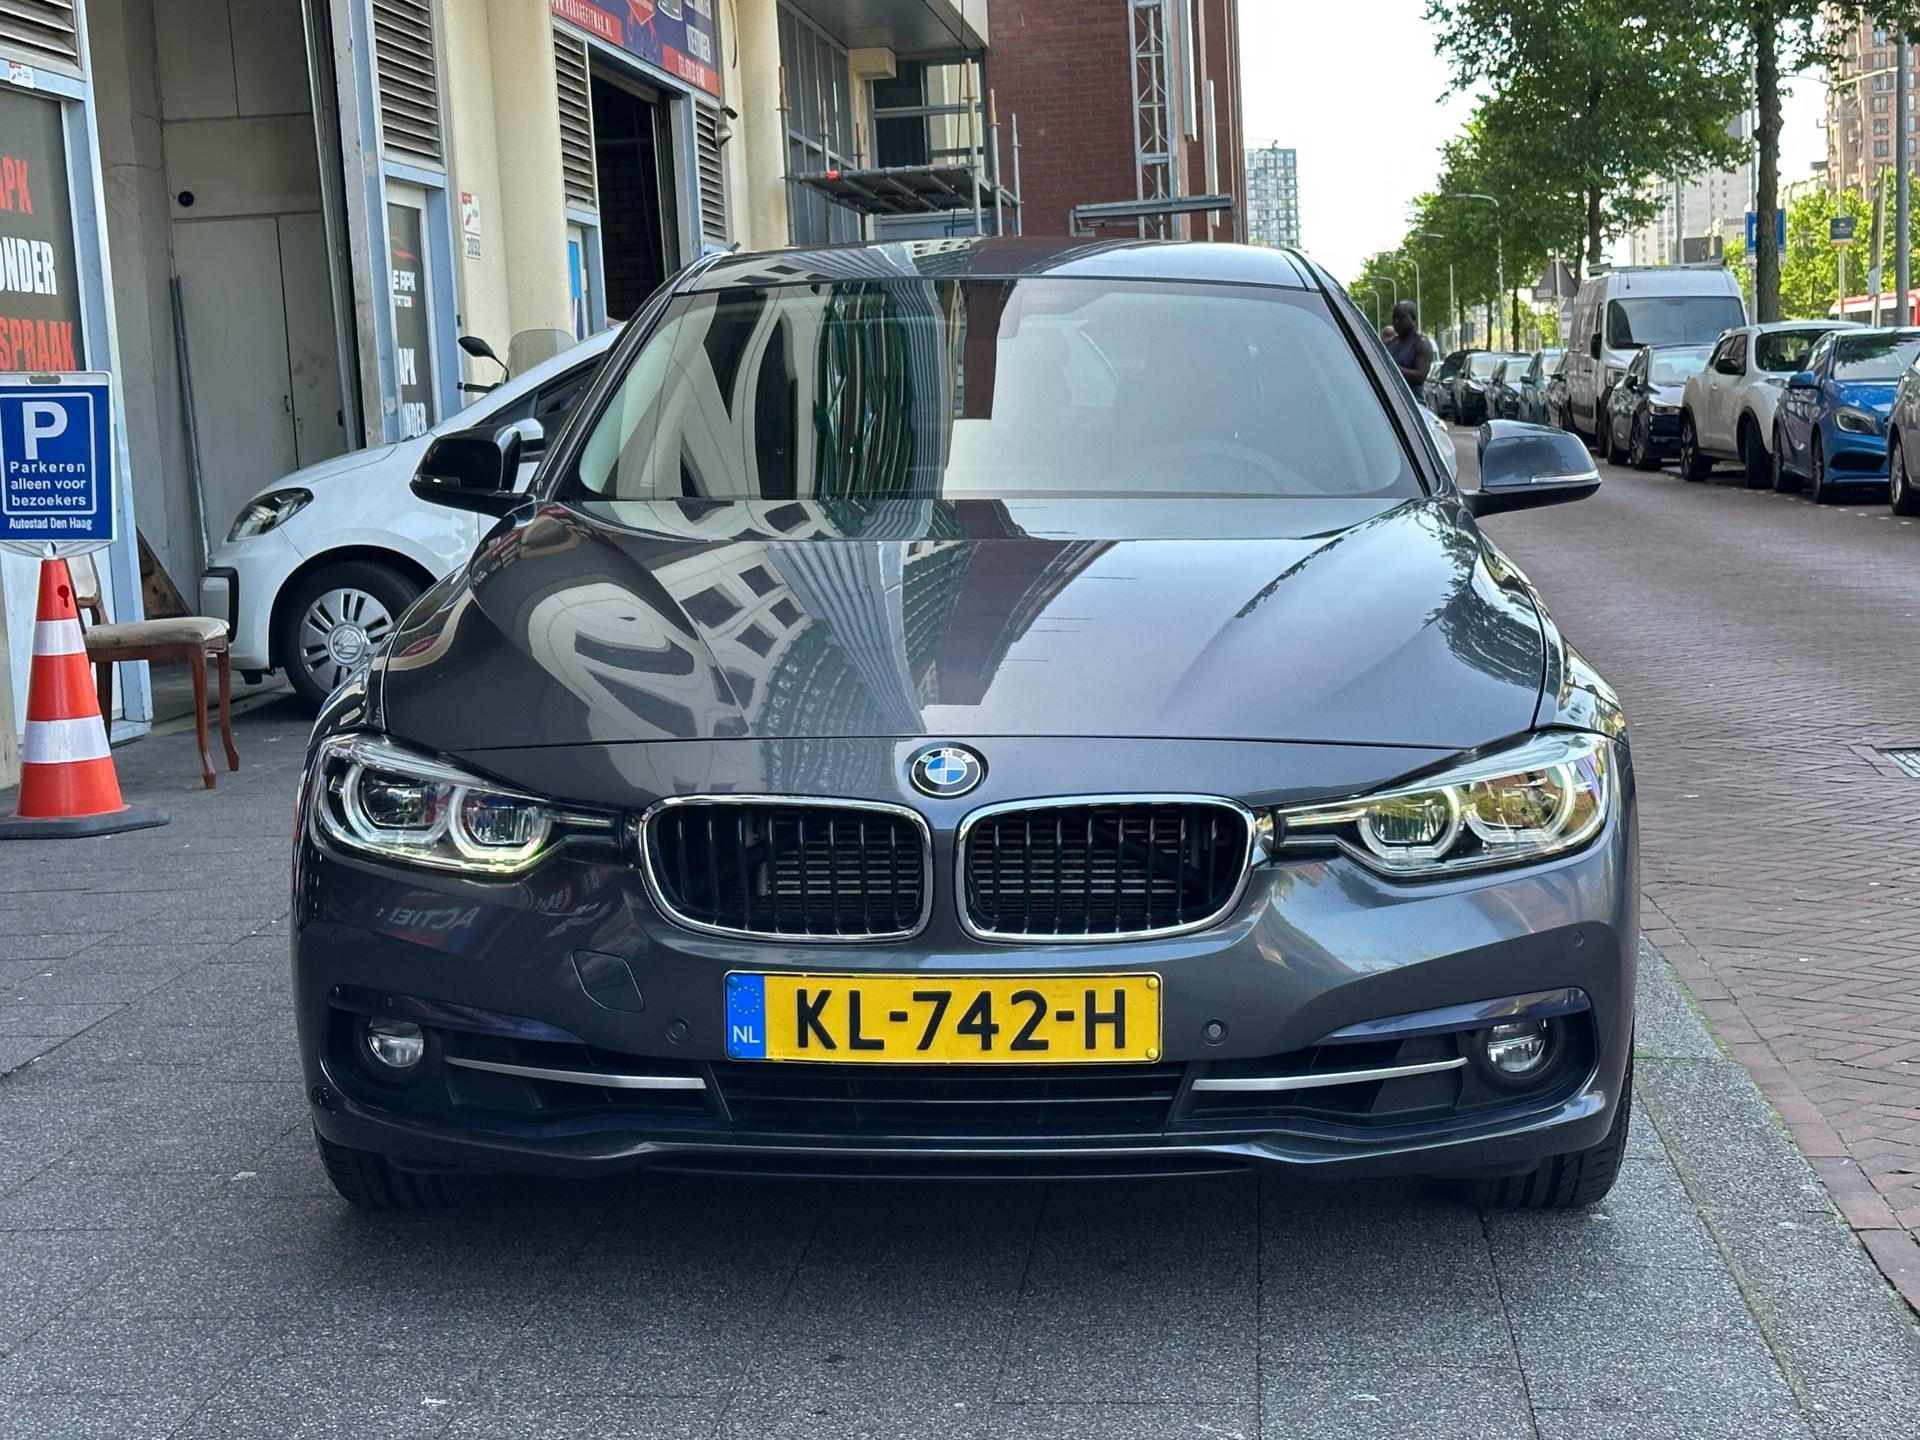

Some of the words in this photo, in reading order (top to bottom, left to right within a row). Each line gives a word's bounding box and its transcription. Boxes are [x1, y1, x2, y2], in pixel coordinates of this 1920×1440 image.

[22, 401, 68, 460] P
[10, 461, 86, 474] Parkeren
[11, 478, 51, 490] alleen
[55, 479, 86, 490] voor
[12, 494, 87, 507] bezoekers
[9, 517, 48, 529] Autostad
[50, 518, 68, 529] Den
[69, 518, 93, 531] Haag
[919, 748, 976, 764] BMW
[733, 1025, 760, 1044] NL
[796, 989, 1126, 1051] KL-742-H
